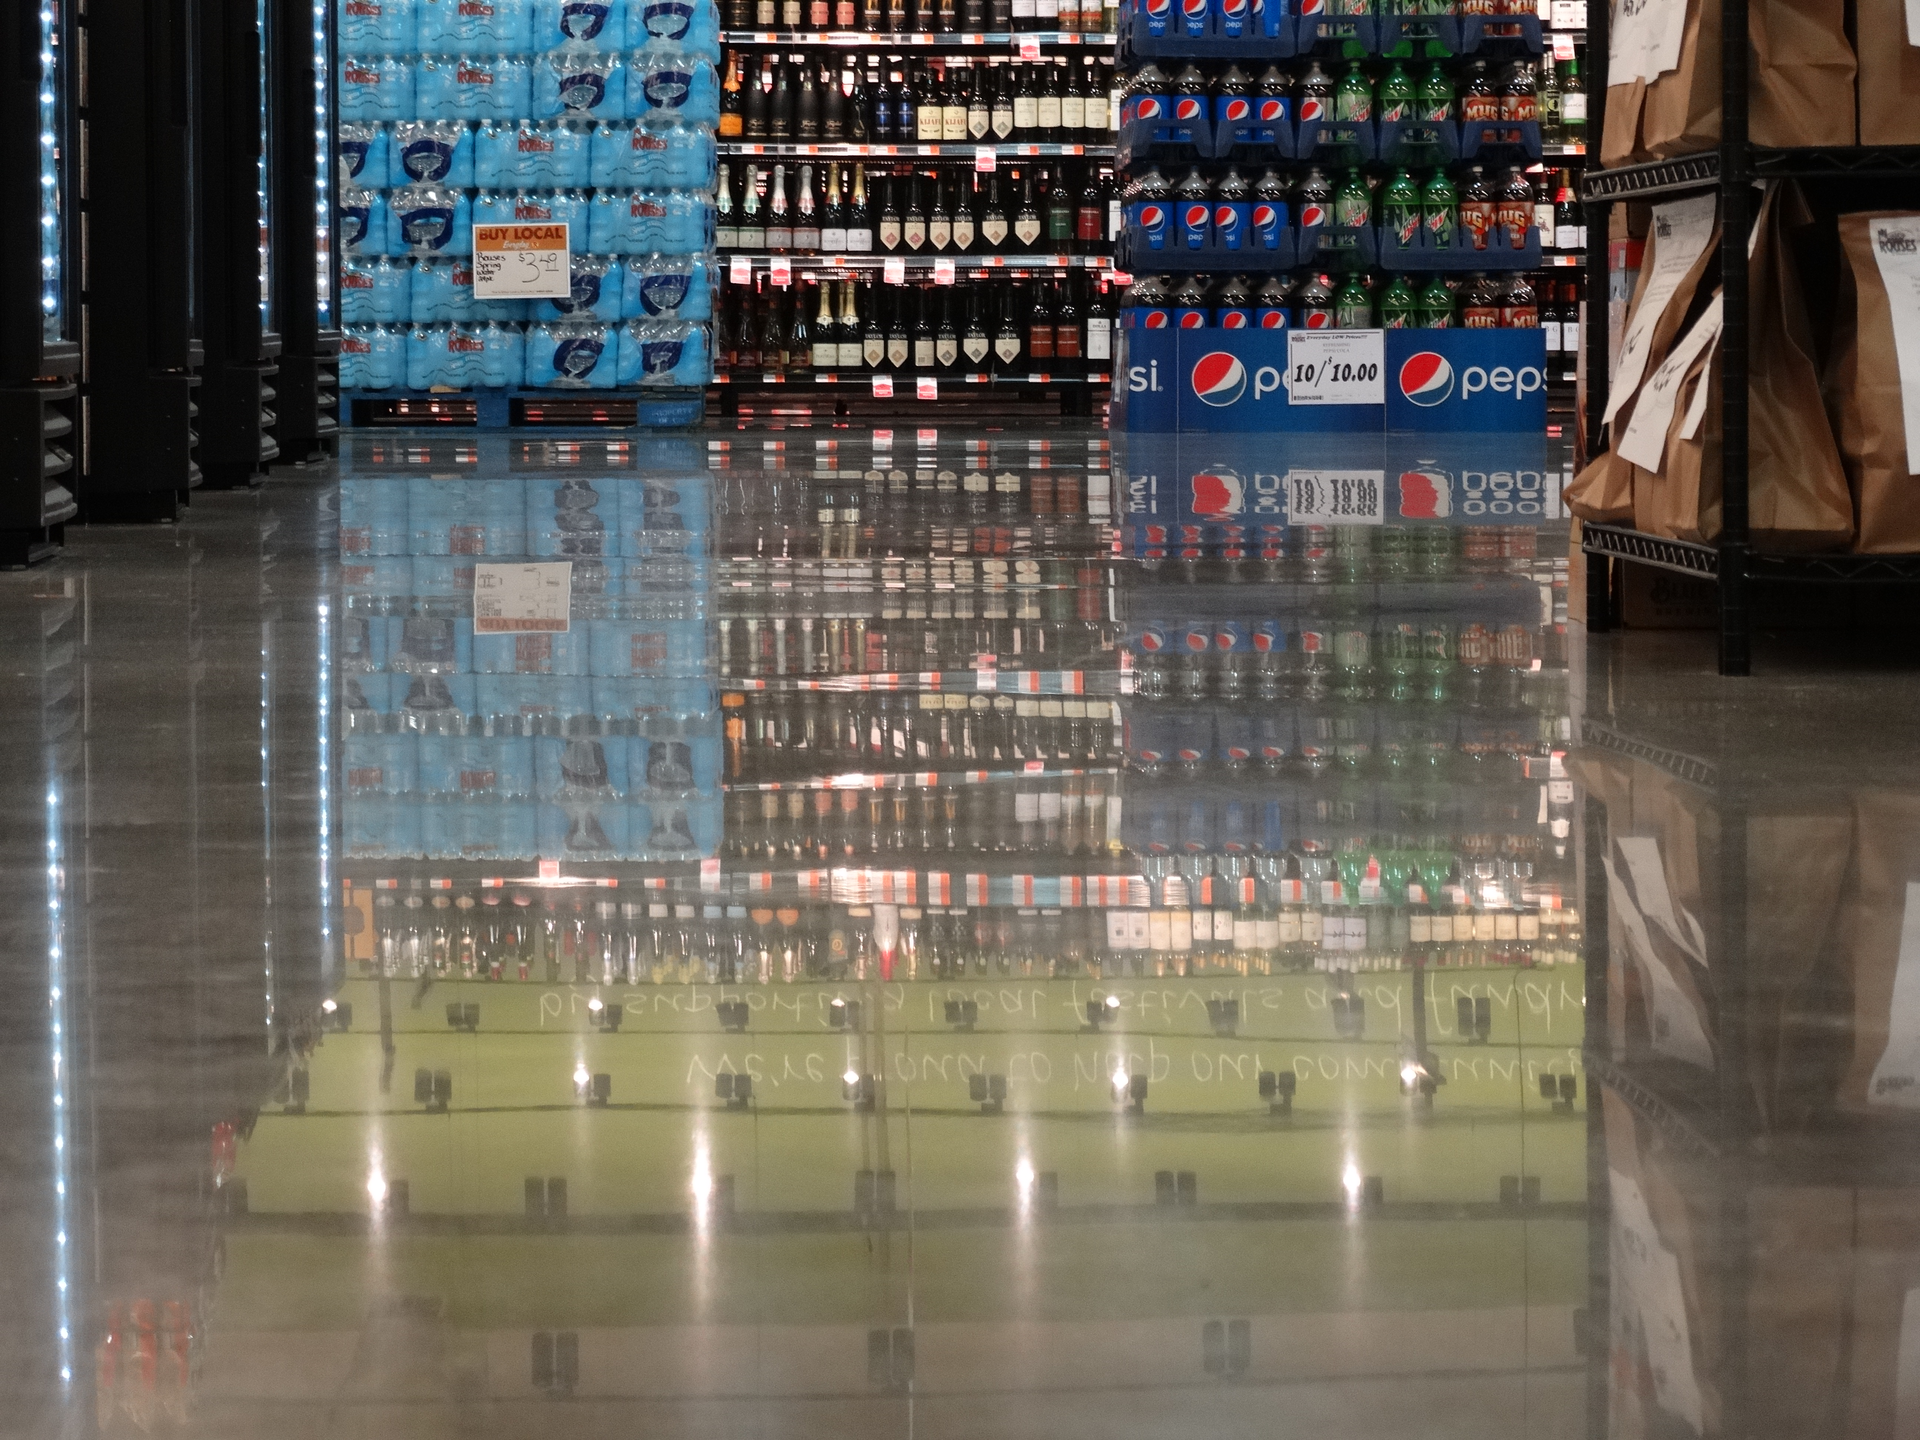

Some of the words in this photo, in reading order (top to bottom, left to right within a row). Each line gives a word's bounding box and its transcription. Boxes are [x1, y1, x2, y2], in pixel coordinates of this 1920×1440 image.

[1466, 105, 1498, 120] MUG
[480, 228, 508, 240] BUY
[514, 228, 563, 240] LOCAL
[1879, 238, 1917, 253] ROUSES
[476, 252, 506, 262] Rouses
[476, 262, 502, 270] Spring
